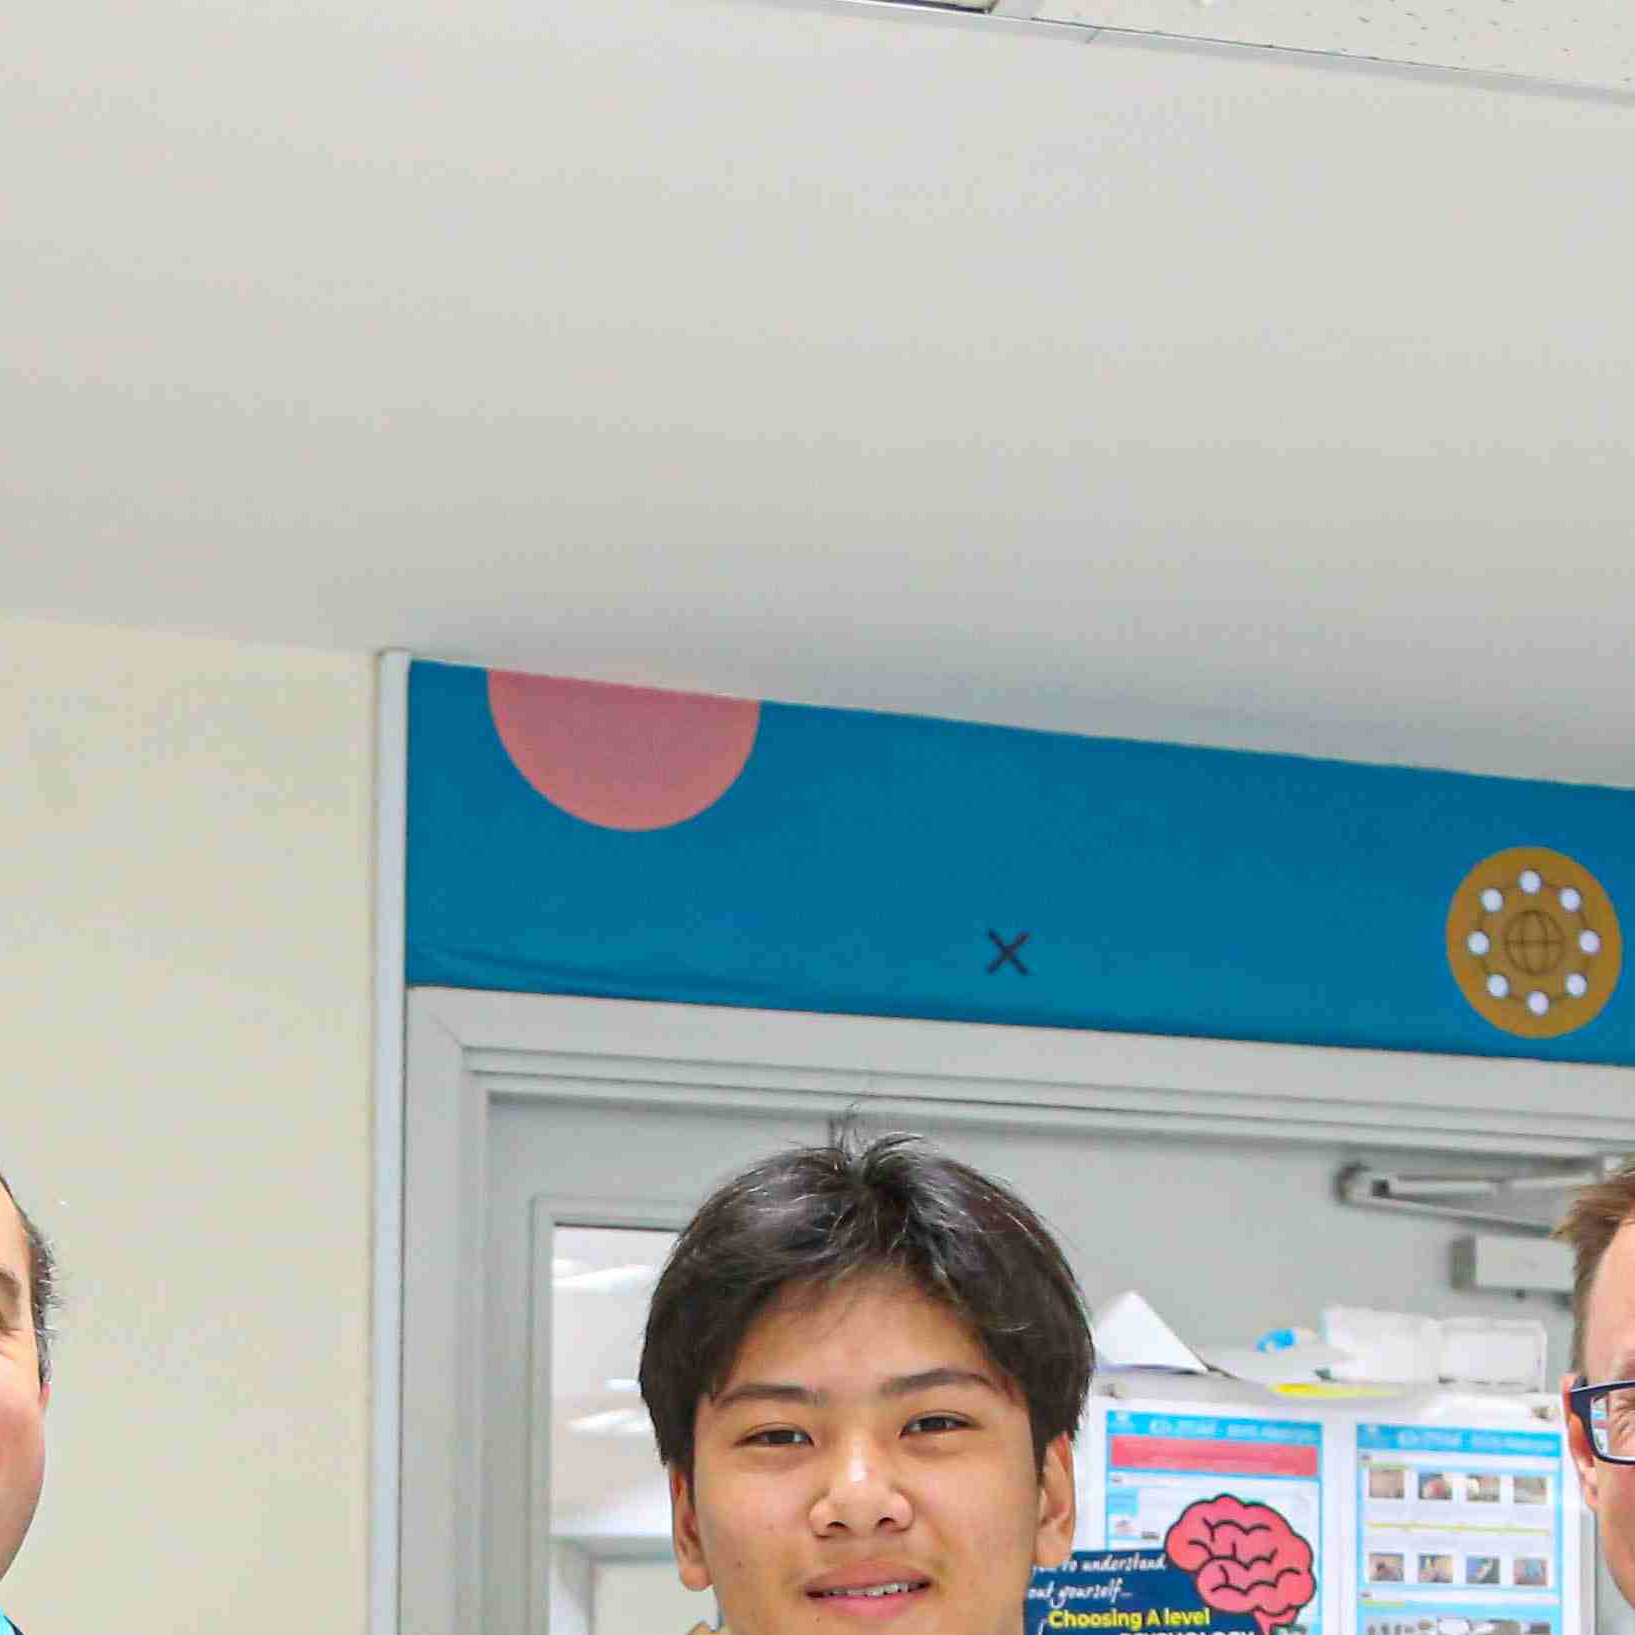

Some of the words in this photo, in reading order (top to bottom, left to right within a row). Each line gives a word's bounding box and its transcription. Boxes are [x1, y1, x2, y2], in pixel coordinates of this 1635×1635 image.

[1048, 1608, 1142, 1630] Choosing
[1146, 1609, 1164, 1625] A
[1165, 1608, 1210, 1625] level
